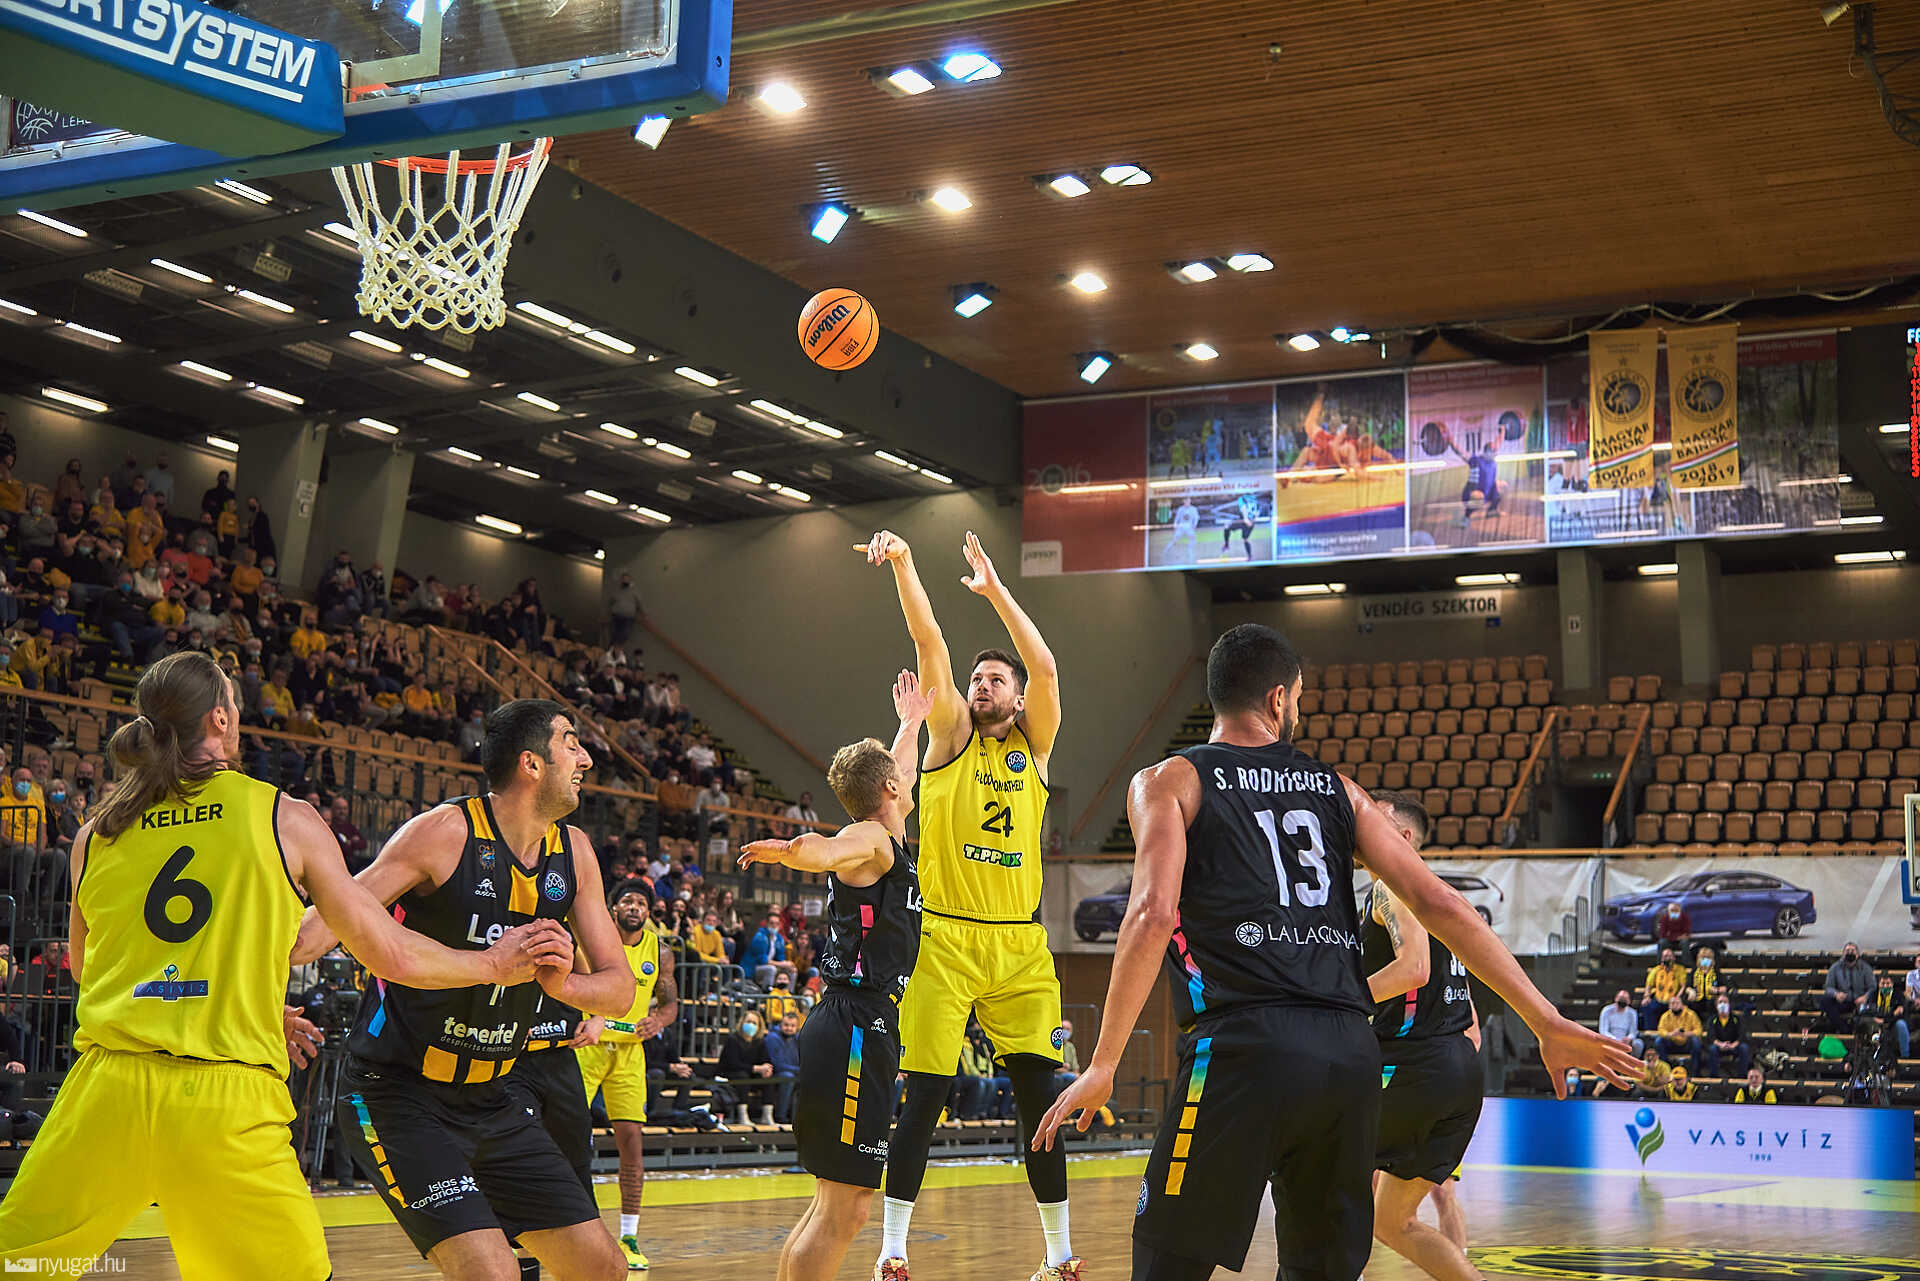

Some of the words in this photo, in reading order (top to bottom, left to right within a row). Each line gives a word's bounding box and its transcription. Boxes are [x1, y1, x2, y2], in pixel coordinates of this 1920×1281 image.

[808, 304, 851, 348] Wilson
[1431, 597, 1497, 616] SZEKTOR
[1213, 766, 1233, 791] S.
[1236, 766, 1336, 797] RODRÍGUEZ
[141, 802, 223, 830] KELLER
[981, 801, 1014, 838] 24
[1253, 809, 1331, 908] 13
[143, 845, 213, 944] 6
[1267, 923, 1292, 944] LA
[1293, 925, 1360, 951] LAGUNA
[1688, 1128, 1832, 1149] VASIVÍZ
[411, 1185, 461, 1209] Canarias
[428, 1178, 458, 1193] Islas
